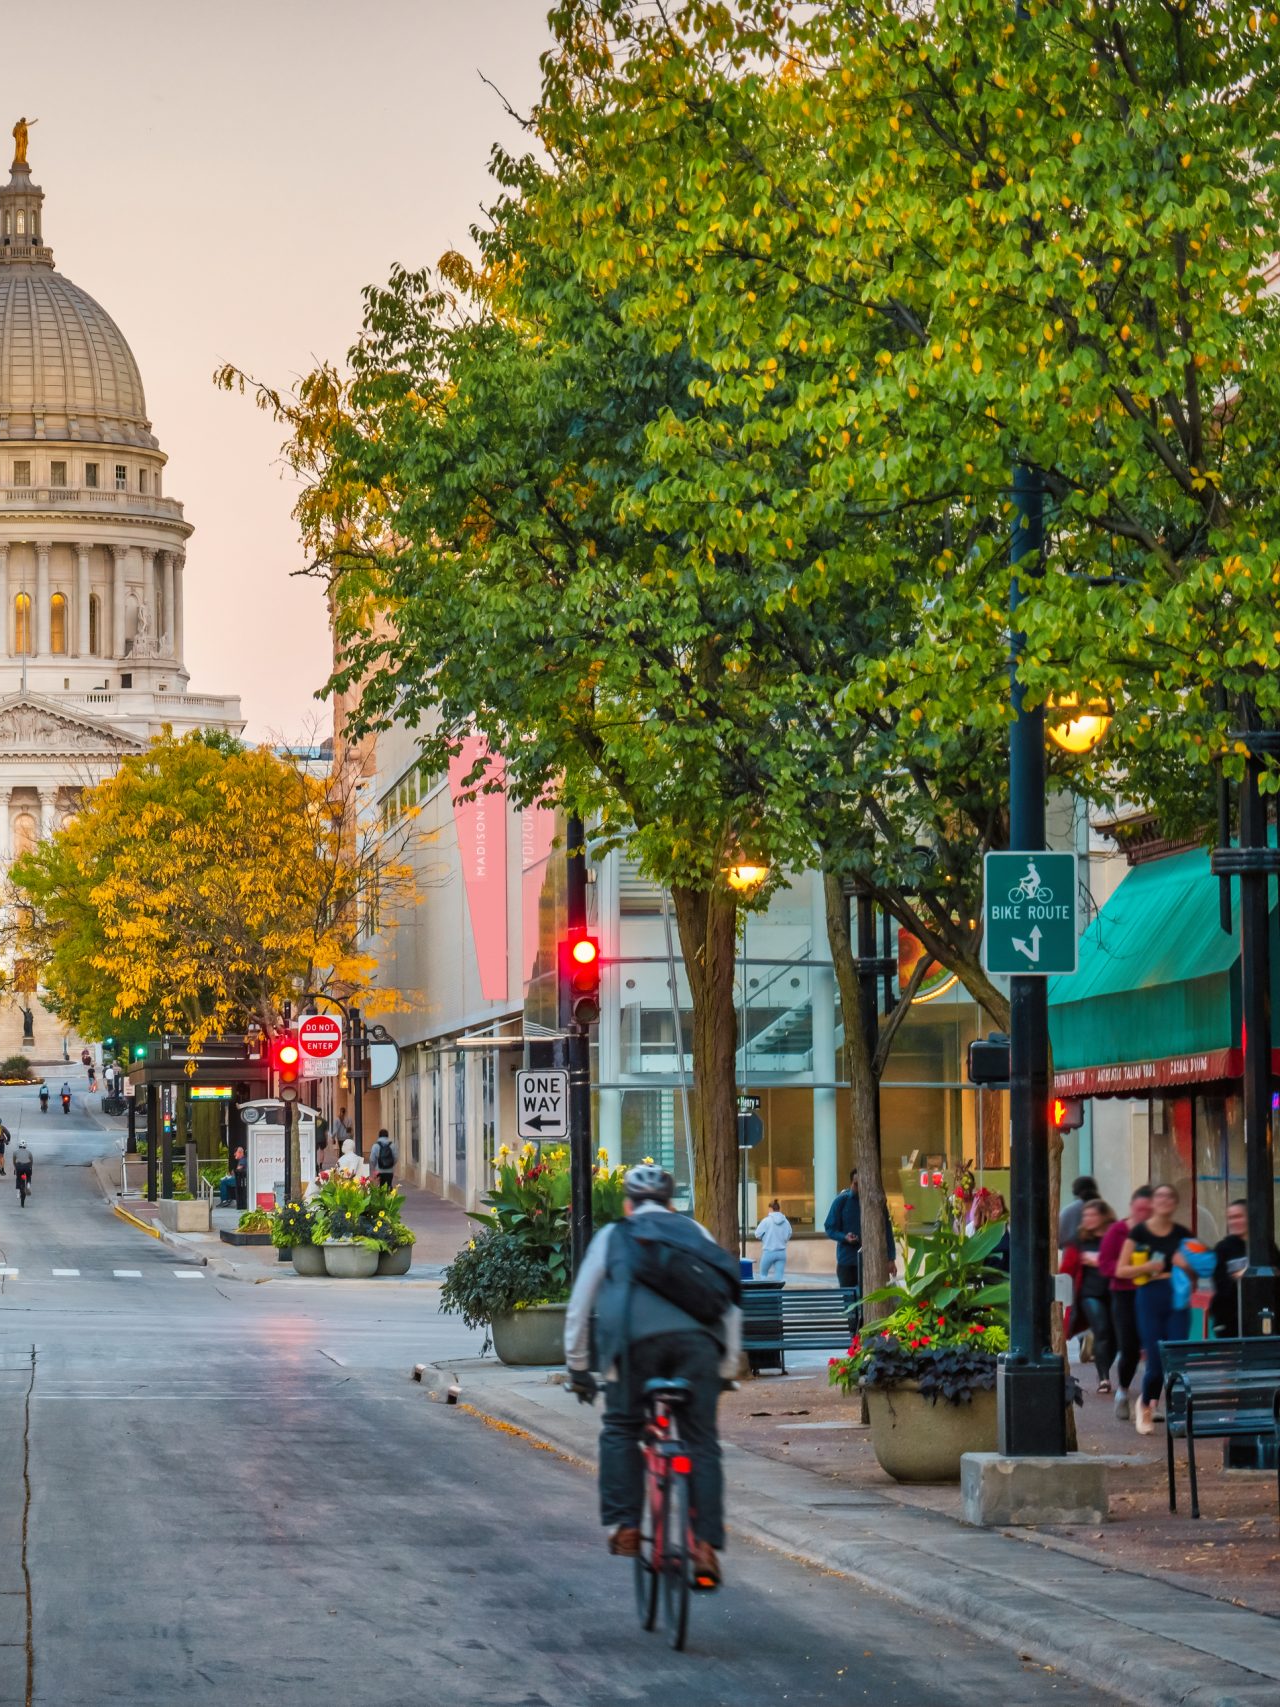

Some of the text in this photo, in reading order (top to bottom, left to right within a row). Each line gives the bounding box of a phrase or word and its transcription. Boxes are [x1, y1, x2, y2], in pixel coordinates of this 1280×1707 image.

[476, 811, 486, 876] MADISON
[992, 905, 1070, 920] BIKE ROUTE
[524, 1078, 561, 1094] ONE
[523, 1097, 561, 1112] WAY
